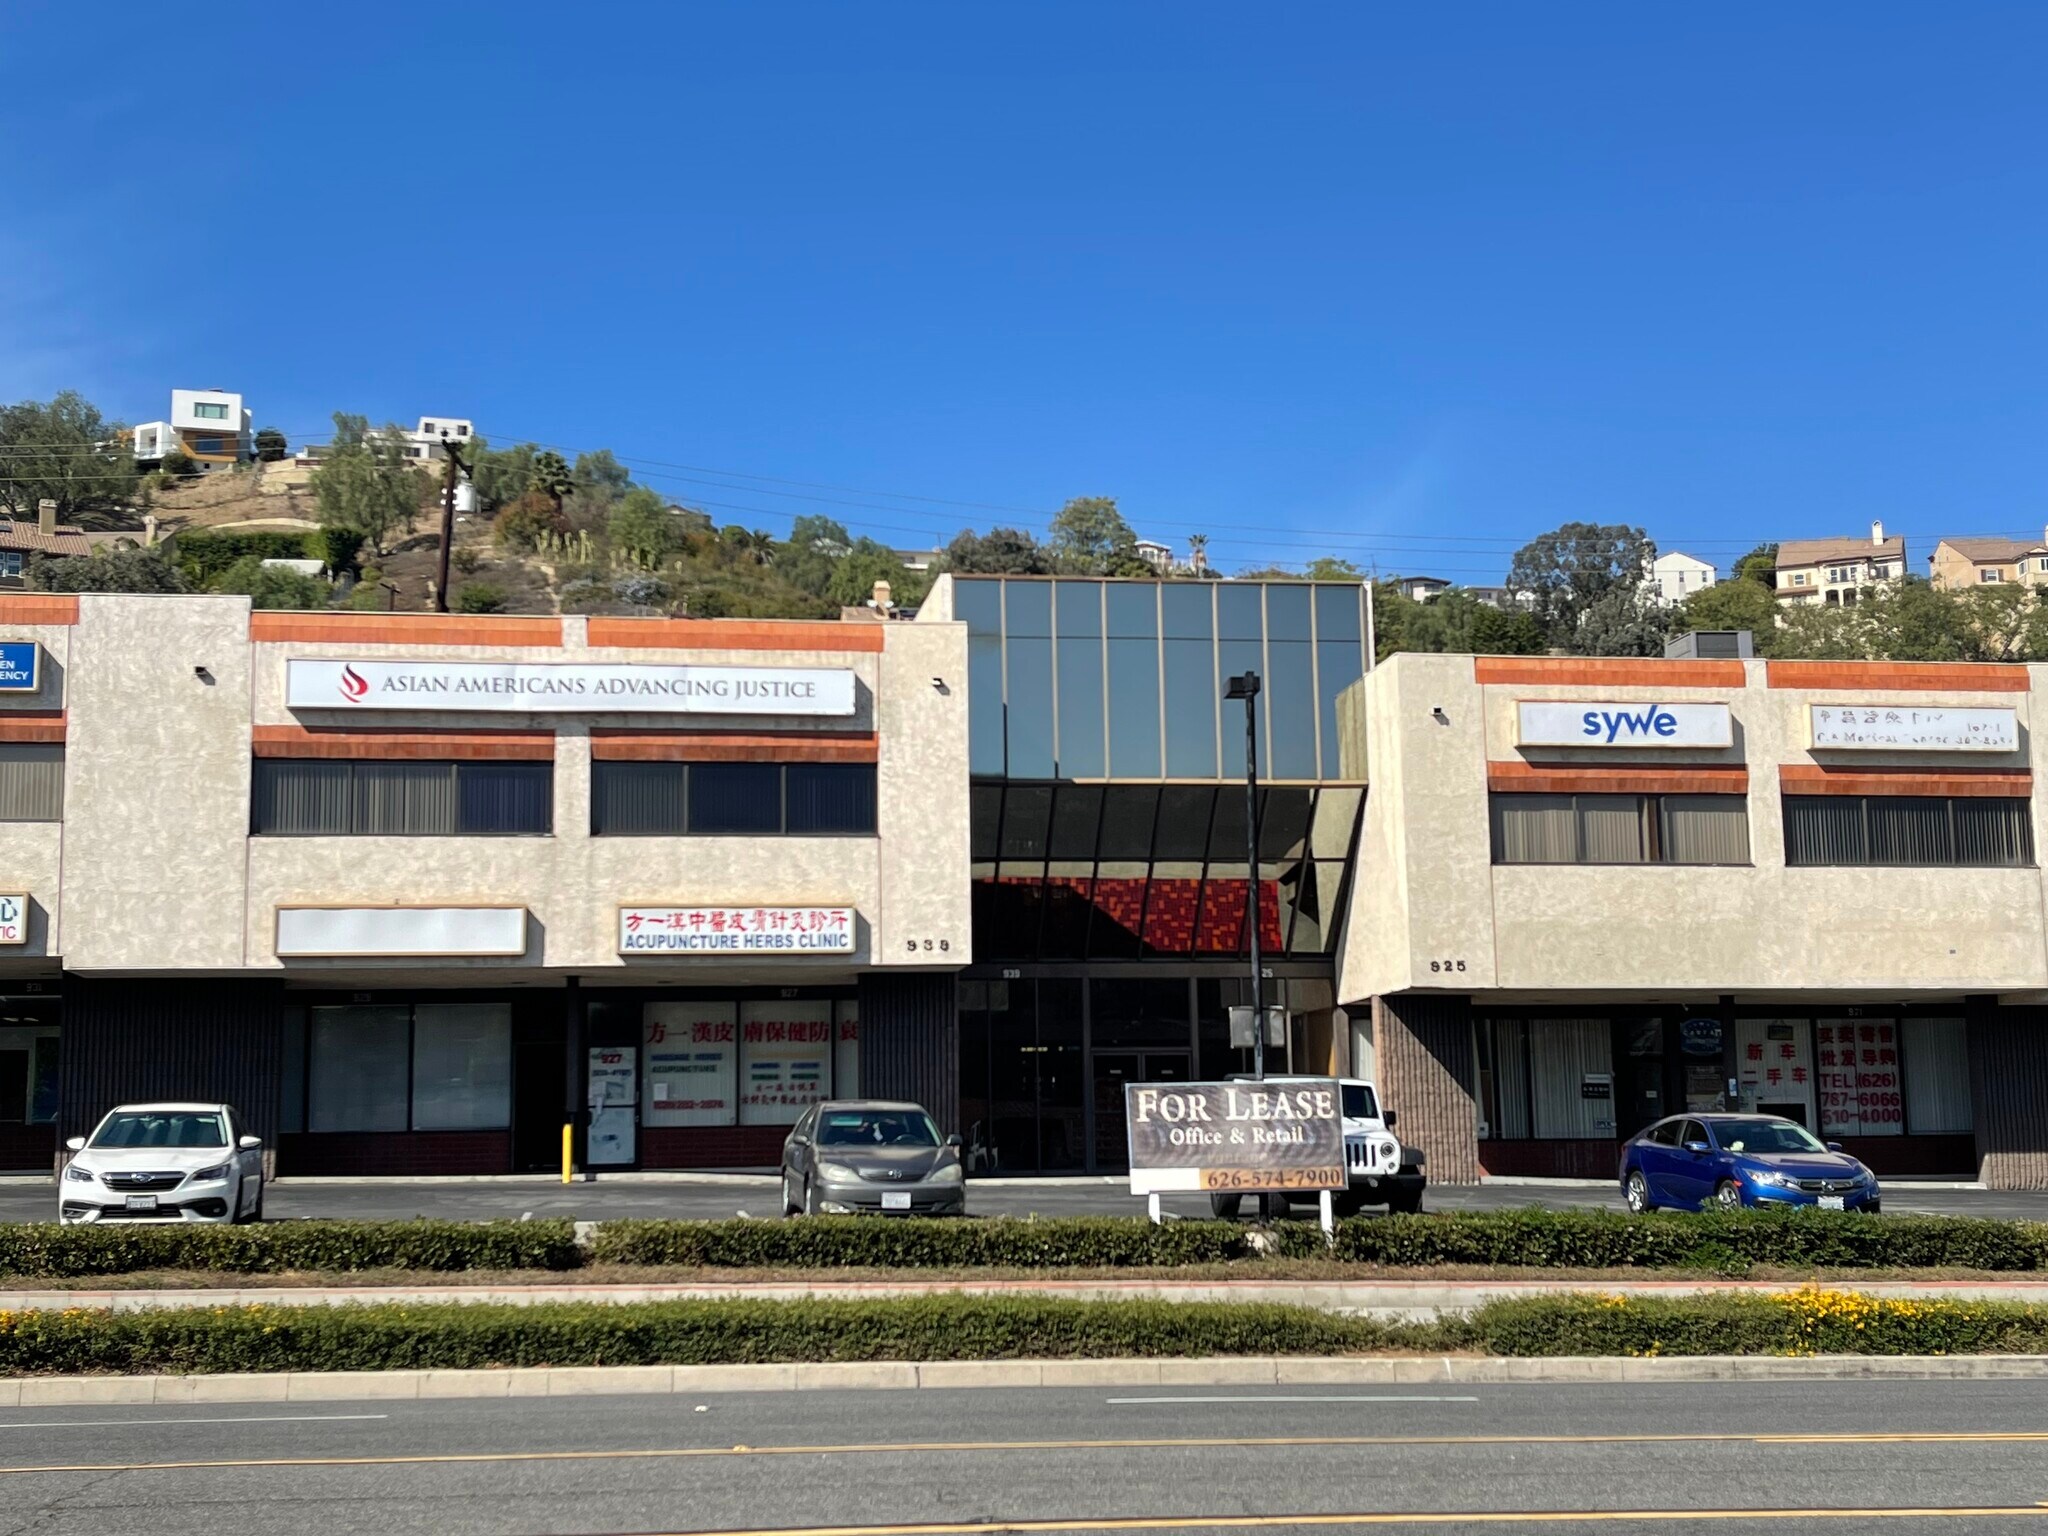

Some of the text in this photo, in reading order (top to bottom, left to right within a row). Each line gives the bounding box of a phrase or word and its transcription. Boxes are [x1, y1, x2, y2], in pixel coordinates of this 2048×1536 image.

[381, 675, 816, 700] ASIAN AMERICANS ADVANCING JUSTICE
[1583, 704, 1677, 743] sywe
[625, 933, 848, 949] ACUPUNCTURE HERBS CLINIC
[1430, 960, 1466, 972] 925
[1136, 1088, 1335, 1123] FOR LEASE
[1820, 1092, 1900, 1107] 787-6066
[1822, 1108, 1901, 1125] 510-4000
[1169, 1126, 1303, 1146] Office & Retail
[1208, 1169, 1340, 1188] 626-574-7900
